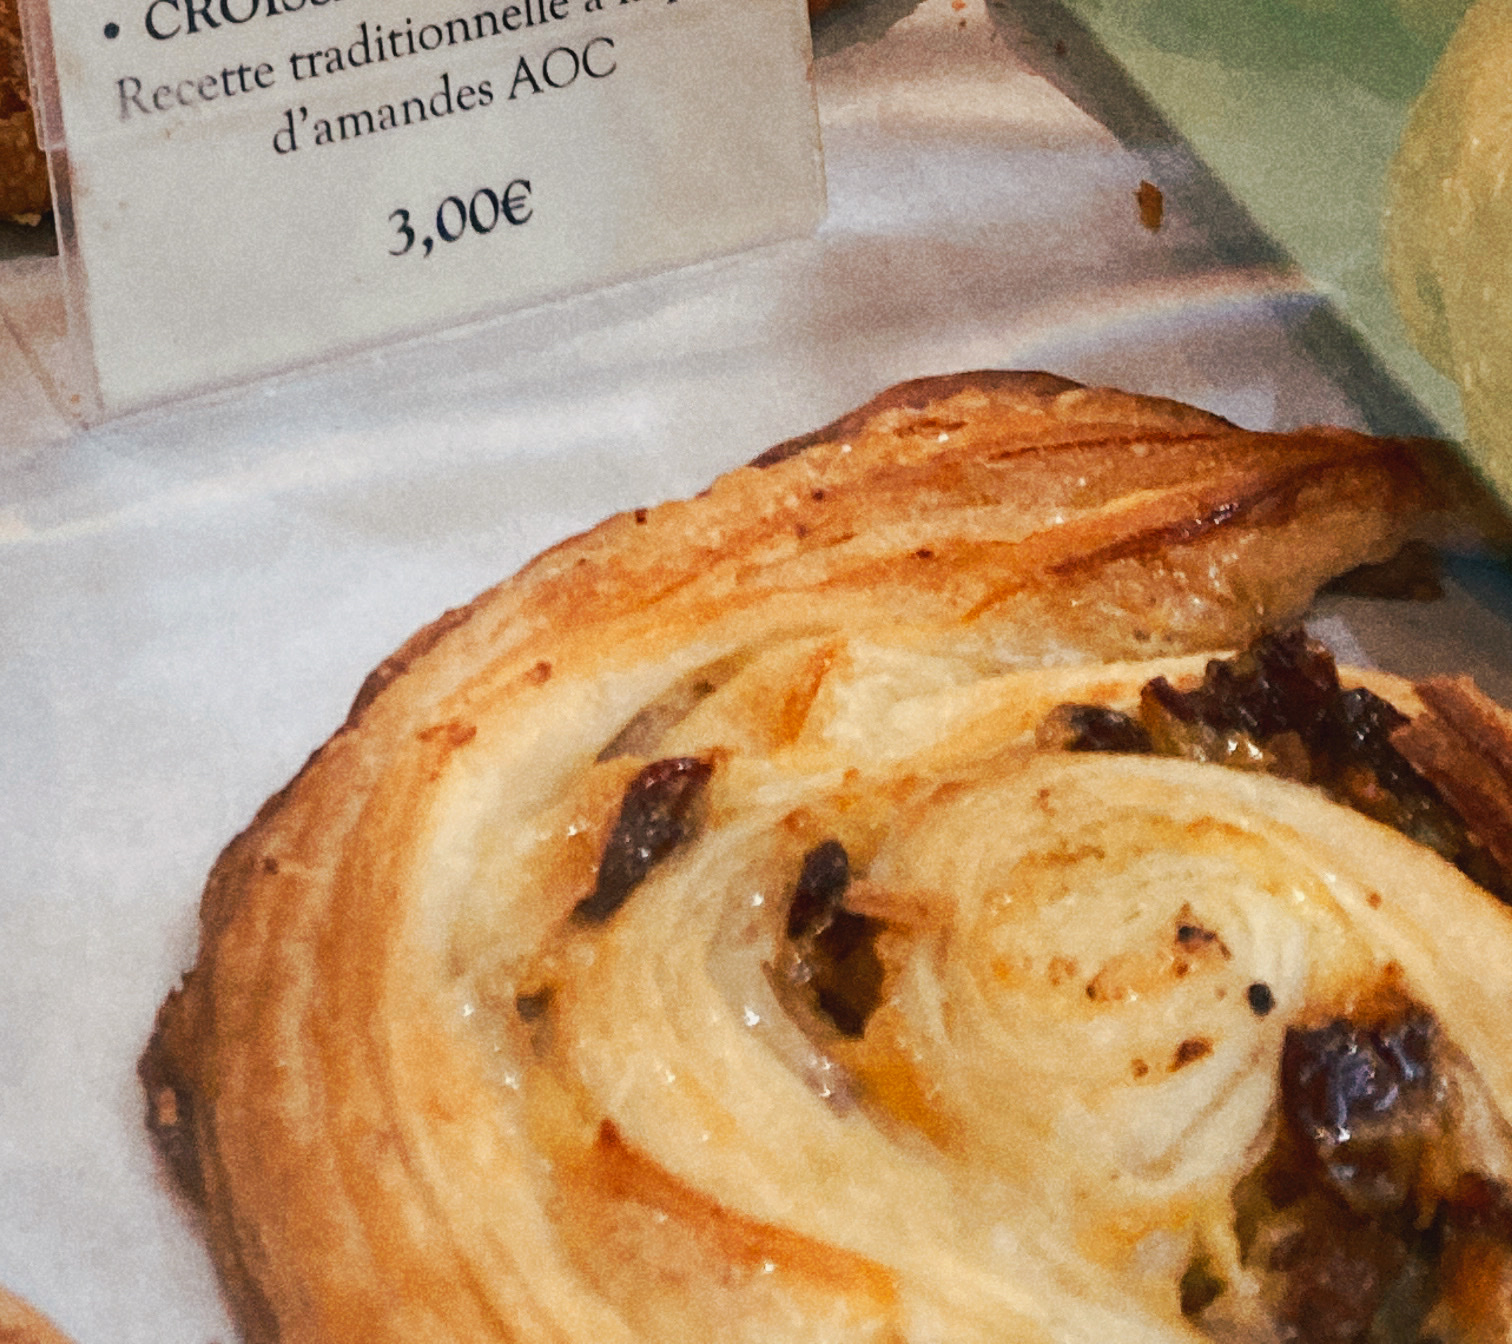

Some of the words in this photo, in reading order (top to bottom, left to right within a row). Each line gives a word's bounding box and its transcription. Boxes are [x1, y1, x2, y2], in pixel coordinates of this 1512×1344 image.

[115, 58, 277, 122] Recette
[507, 36, 618, 100] AOC
[386, 179, 535, 260] 3,00€
